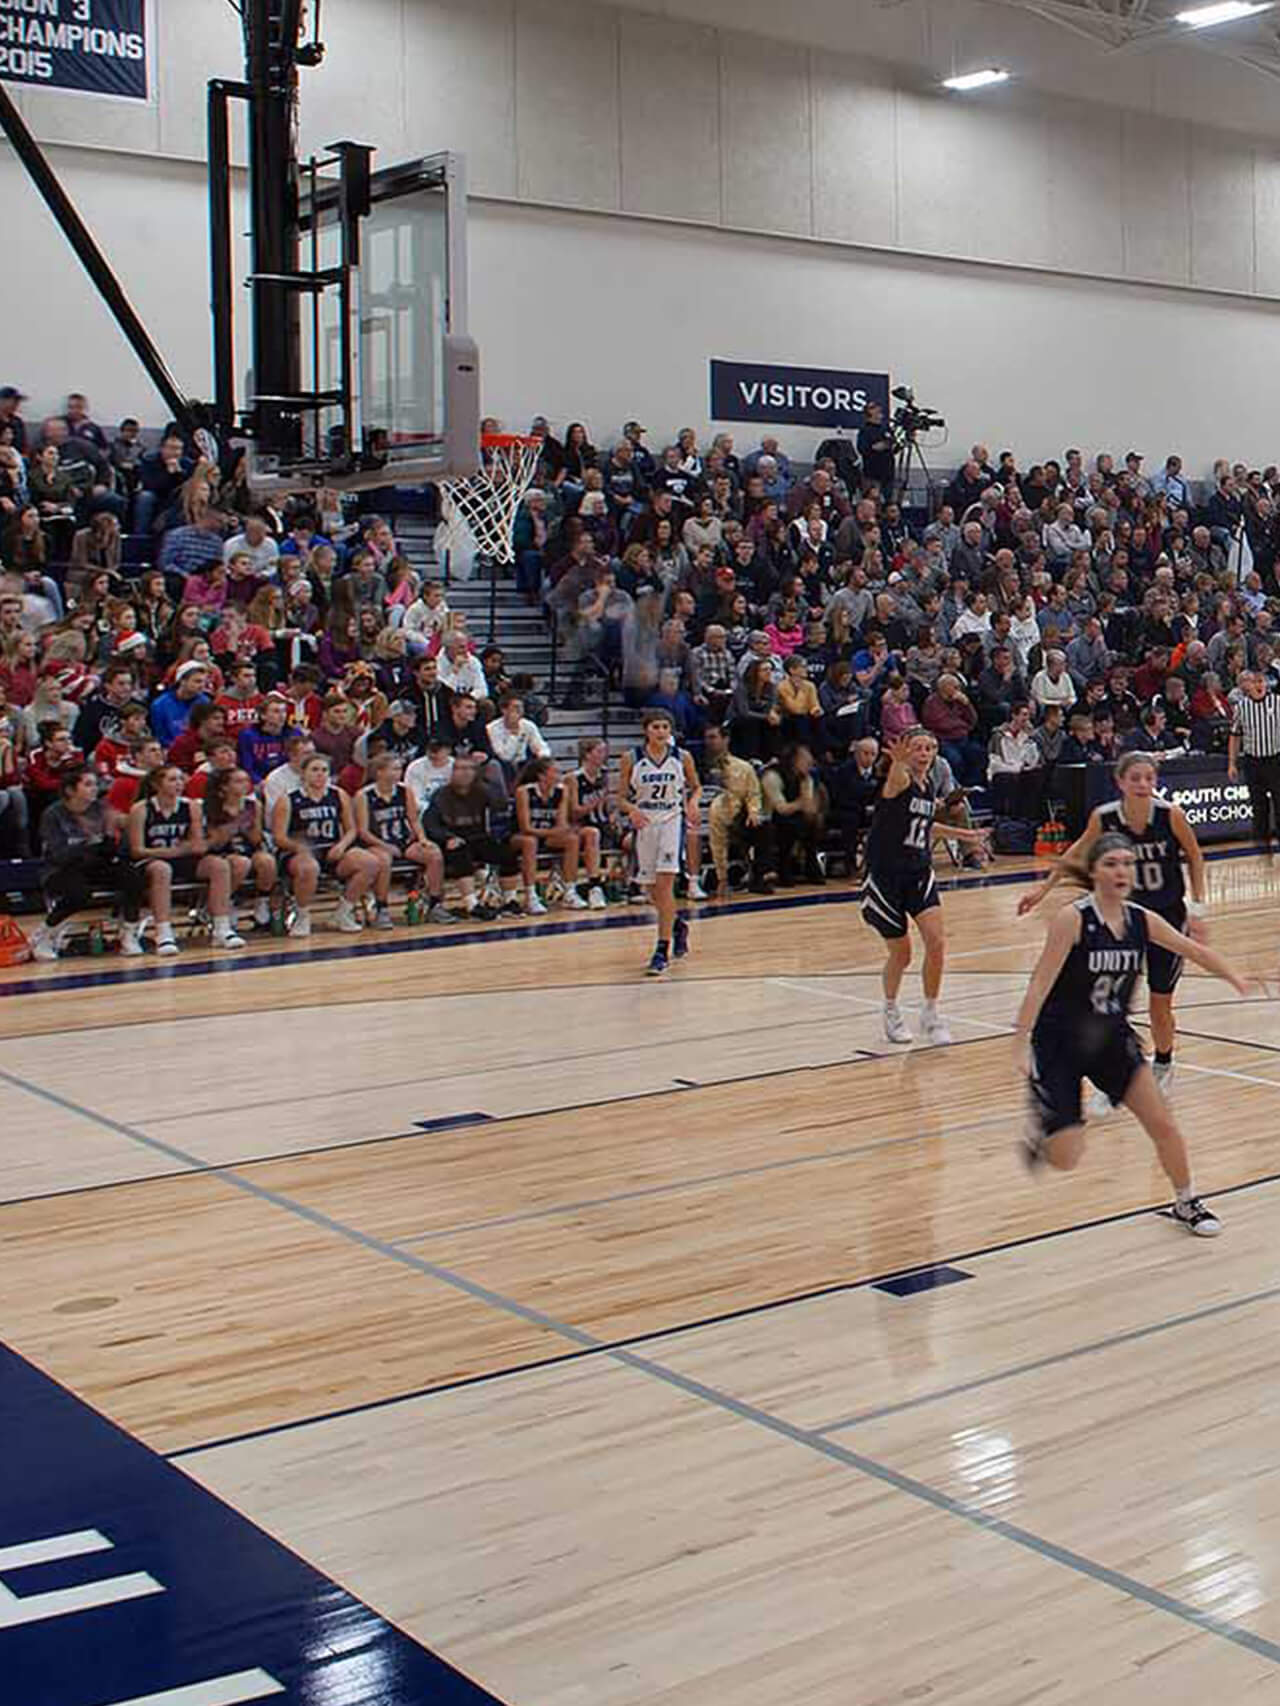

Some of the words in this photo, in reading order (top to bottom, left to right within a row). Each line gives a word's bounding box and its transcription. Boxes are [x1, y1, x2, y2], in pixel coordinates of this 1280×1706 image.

[73, 0, 91, 21] 3
[0, 46, 53, 78] 2015
[739, 381, 867, 411] VISITORS
[651, 783, 669, 800] 21
[1172, 787, 1222, 806] SOUTH
[1133, 841, 1167, 860] ITY
